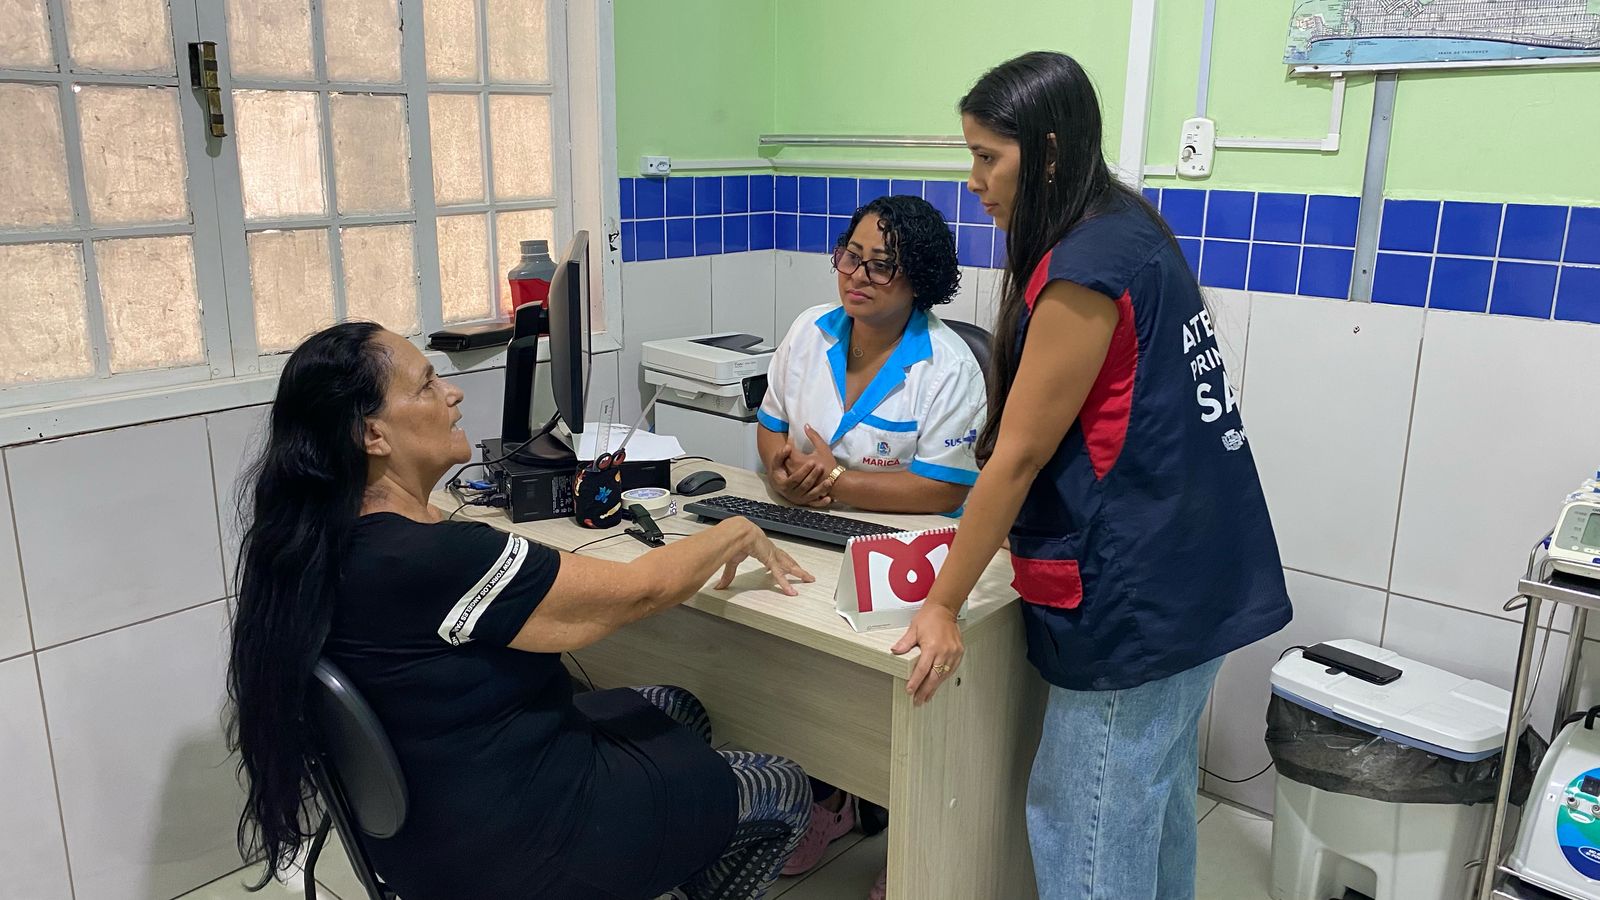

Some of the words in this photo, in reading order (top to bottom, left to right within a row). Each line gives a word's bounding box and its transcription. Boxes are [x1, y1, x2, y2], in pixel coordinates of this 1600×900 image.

[944, 438, 962, 448] SUS
[502, 557, 514, 572] NEW
[490, 568, 505, 586] YORK
[480, 584, 492, 597] LOS
[460, 594, 482, 621] ANGELES
